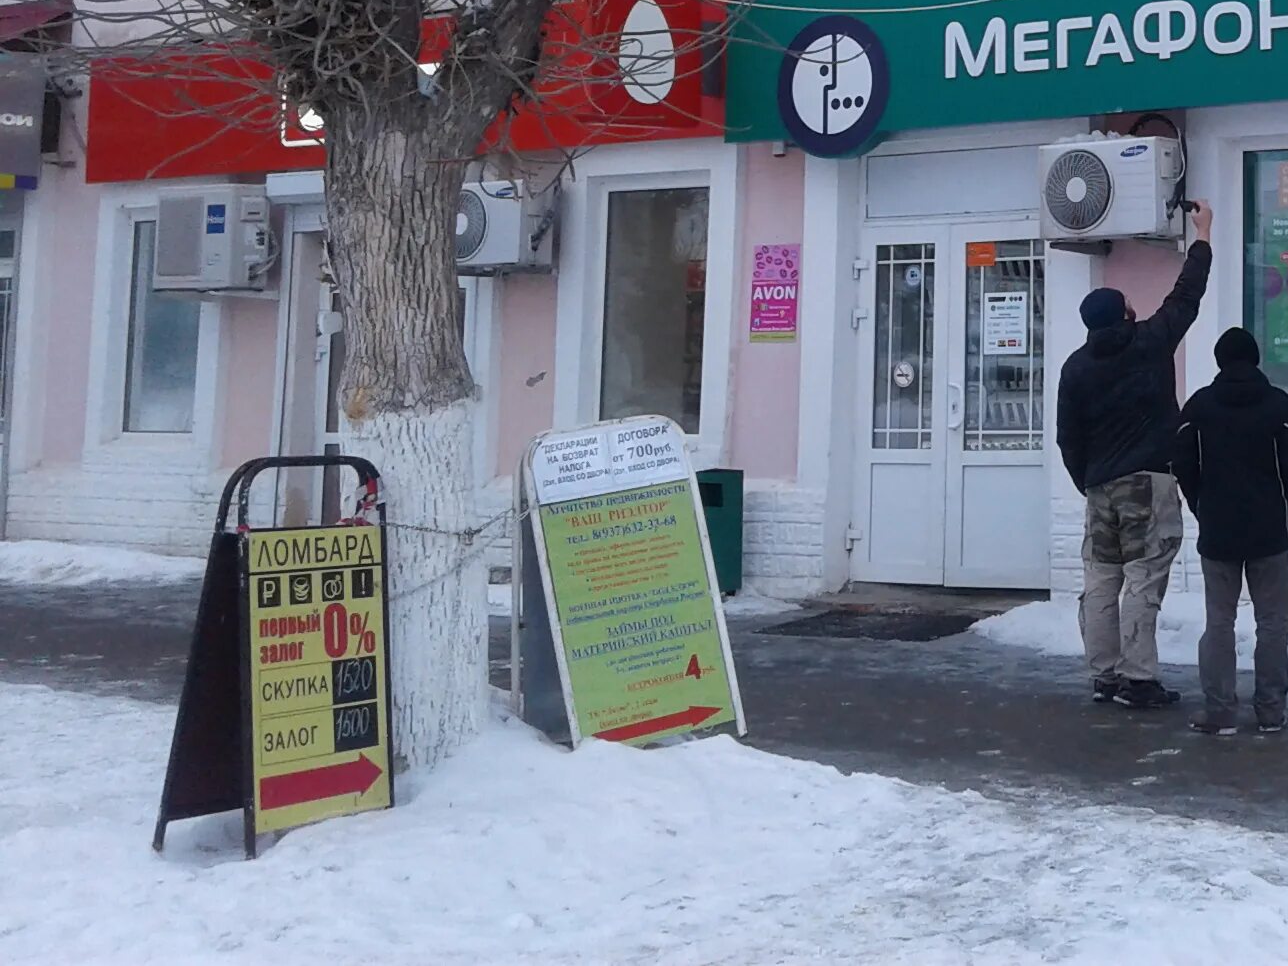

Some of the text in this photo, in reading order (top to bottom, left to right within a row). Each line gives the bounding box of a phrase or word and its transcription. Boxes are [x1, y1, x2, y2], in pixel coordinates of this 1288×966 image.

[753, 285, 796, 301] AVON
[547, 447, 599, 465] НА ВОЗВРАТ
[612, 453, 624, 463] от
[647, 459, 656, 469] СО
[558, 461, 592, 474] НАЛОГА
[576, 472, 586, 481] СО
[547, 485, 686, 517] Агентство недвижимости
[257, 534, 375, 567] ЛОМБАРД
[259, 602, 376, 658] первый 0%
[606, 617, 648, 635] ЗАЙМЫ
[260, 641, 305, 664] залог
[685, 653, 701, 680] 4
[262, 675, 329, 702] СКУПКА
[264, 725, 318, 753] ЗАЛОГ
